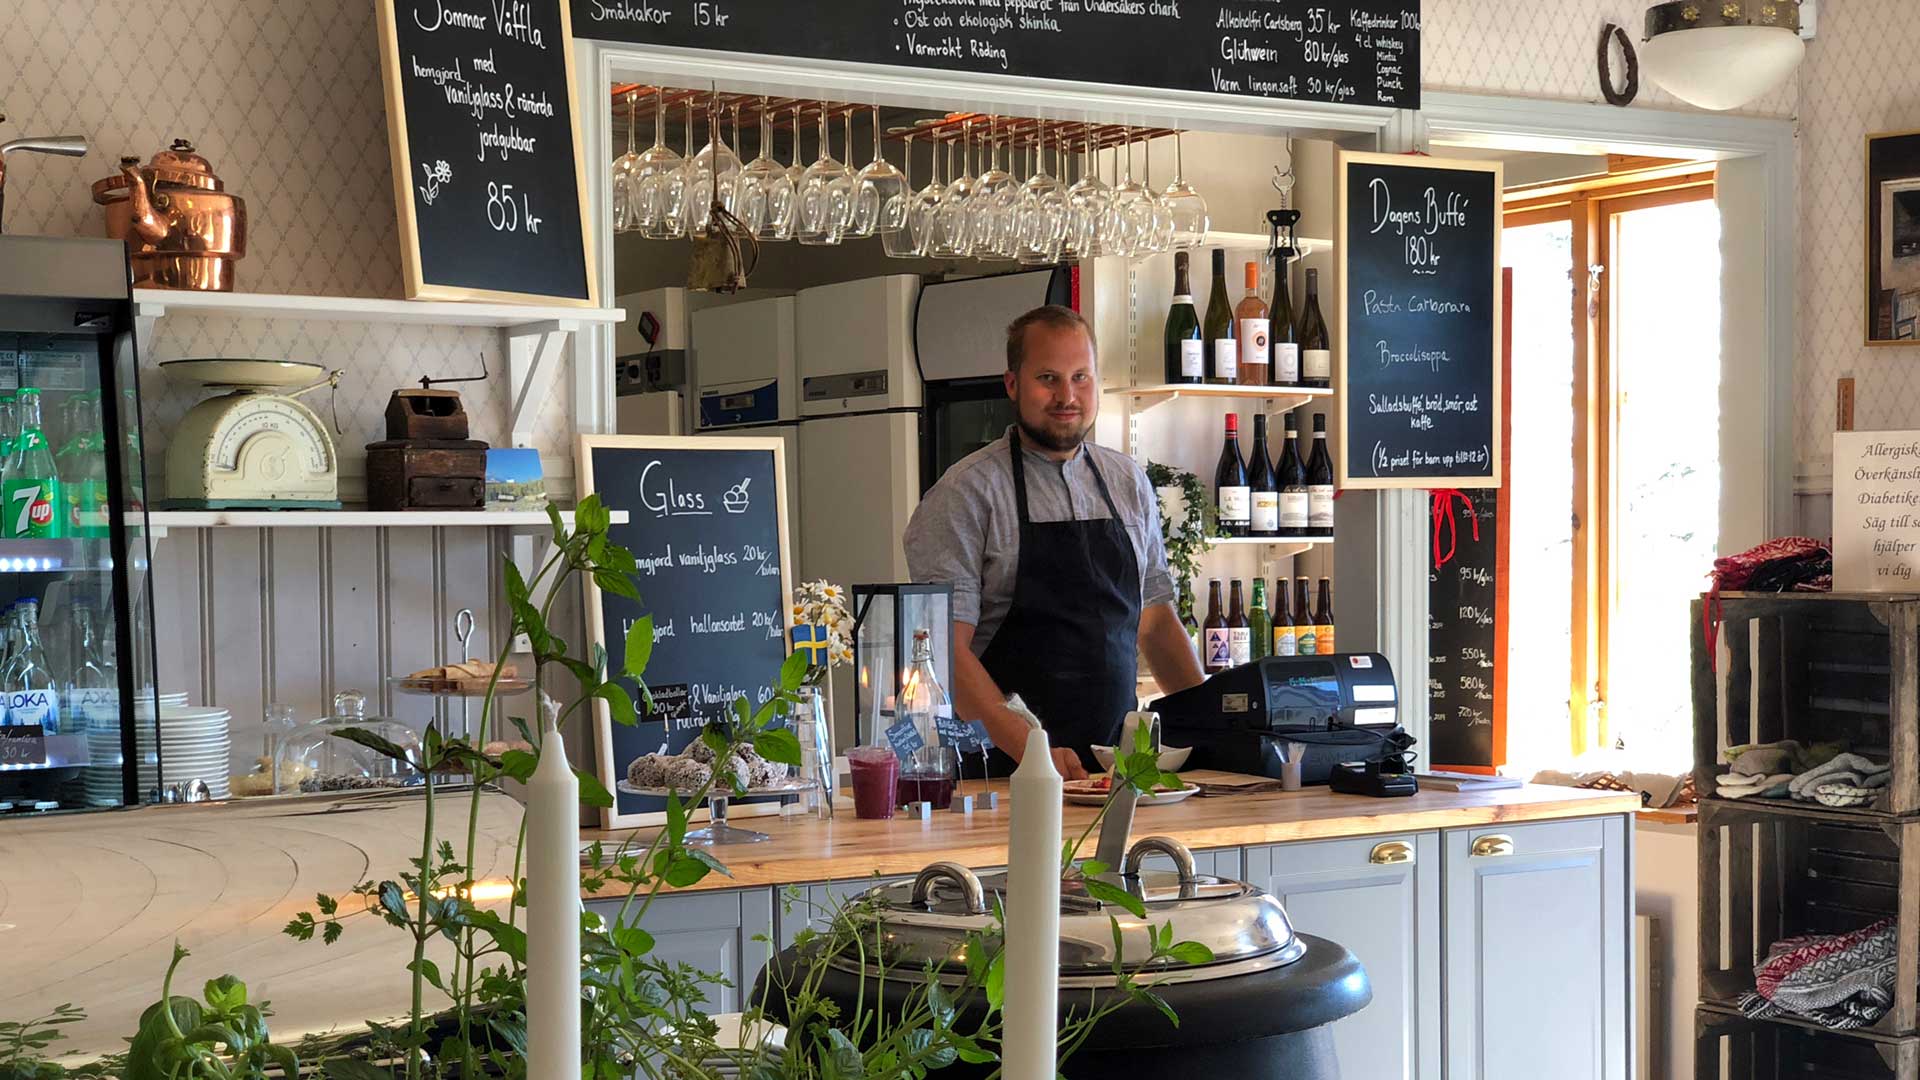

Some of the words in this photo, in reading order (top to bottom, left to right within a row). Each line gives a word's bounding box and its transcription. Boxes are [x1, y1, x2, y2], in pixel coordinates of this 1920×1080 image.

[590, 0, 672, 25] Småkakor
[693, 3, 711, 26] 15
[714, 4, 729, 27] kr
[1148, 0, 1181, 19] chark
[904, 10, 930, 28] Ost
[959, 10, 1013, 35] ekologisk
[1018, 11, 1062, 32] skinka
[1263, 12, 1304, 42] Carlsberg
[1307, 7, 1326, 33] 35
[1328, 9, 1341, 34] kr
[1221, 36, 1278, 65] Glühwein
[1304, 40, 1320, 63] 80
[1355, 33, 1362, 48] 4
[412, 54, 466, 85] hemgjord
[473, 47, 497, 74] med
[1376, 62, 1403, 77] Cognac
[1211, 67, 1241, 92] Varm
[1248, 74, 1298, 97] lingonsaft
[1307, 77, 1322, 94] 30
[1376, 76, 1404, 90] Punch
[505, 83, 515, 118] &
[476, 122, 536, 162] jordgubbar
[487, 181, 517, 232] 85
[524, 192, 542, 235] kr
[1369, 177, 1421, 235] Dagens
[1423, 186, 1469, 235] Buffé
[1405, 235, 1427, 266] 180
[1430, 241, 1440, 266] kr
[1408, 295, 1471, 314] Carbonara
[1375, 340, 1451, 374] Broccolisoppa
[1412, 450, 1424, 469] för
[640, 460, 705, 517] Glass
[12, 485, 41, 535] 7
[31, 503, 50, 521] up
[1862, 515, 1886, 532] Säg
[1889, 514, 1909, 529] till
[634, 543, 674, 576] mgjord
[743, 544, 757, 561] 20
[1873, 538, 1917, 557] hjälper
[1459, 566, 1472, 580] 95
[1877, 563, 1890, 577] vi
[1892, 562, 1912, 580] dig
[752, 611, 764, 627] 20
[1459, 606, 1474, 619] 120
[1461, 647, 1480, 660] 550
[1460, 676, 1478, 690] 580
[652, 702, 666, 715] 30
